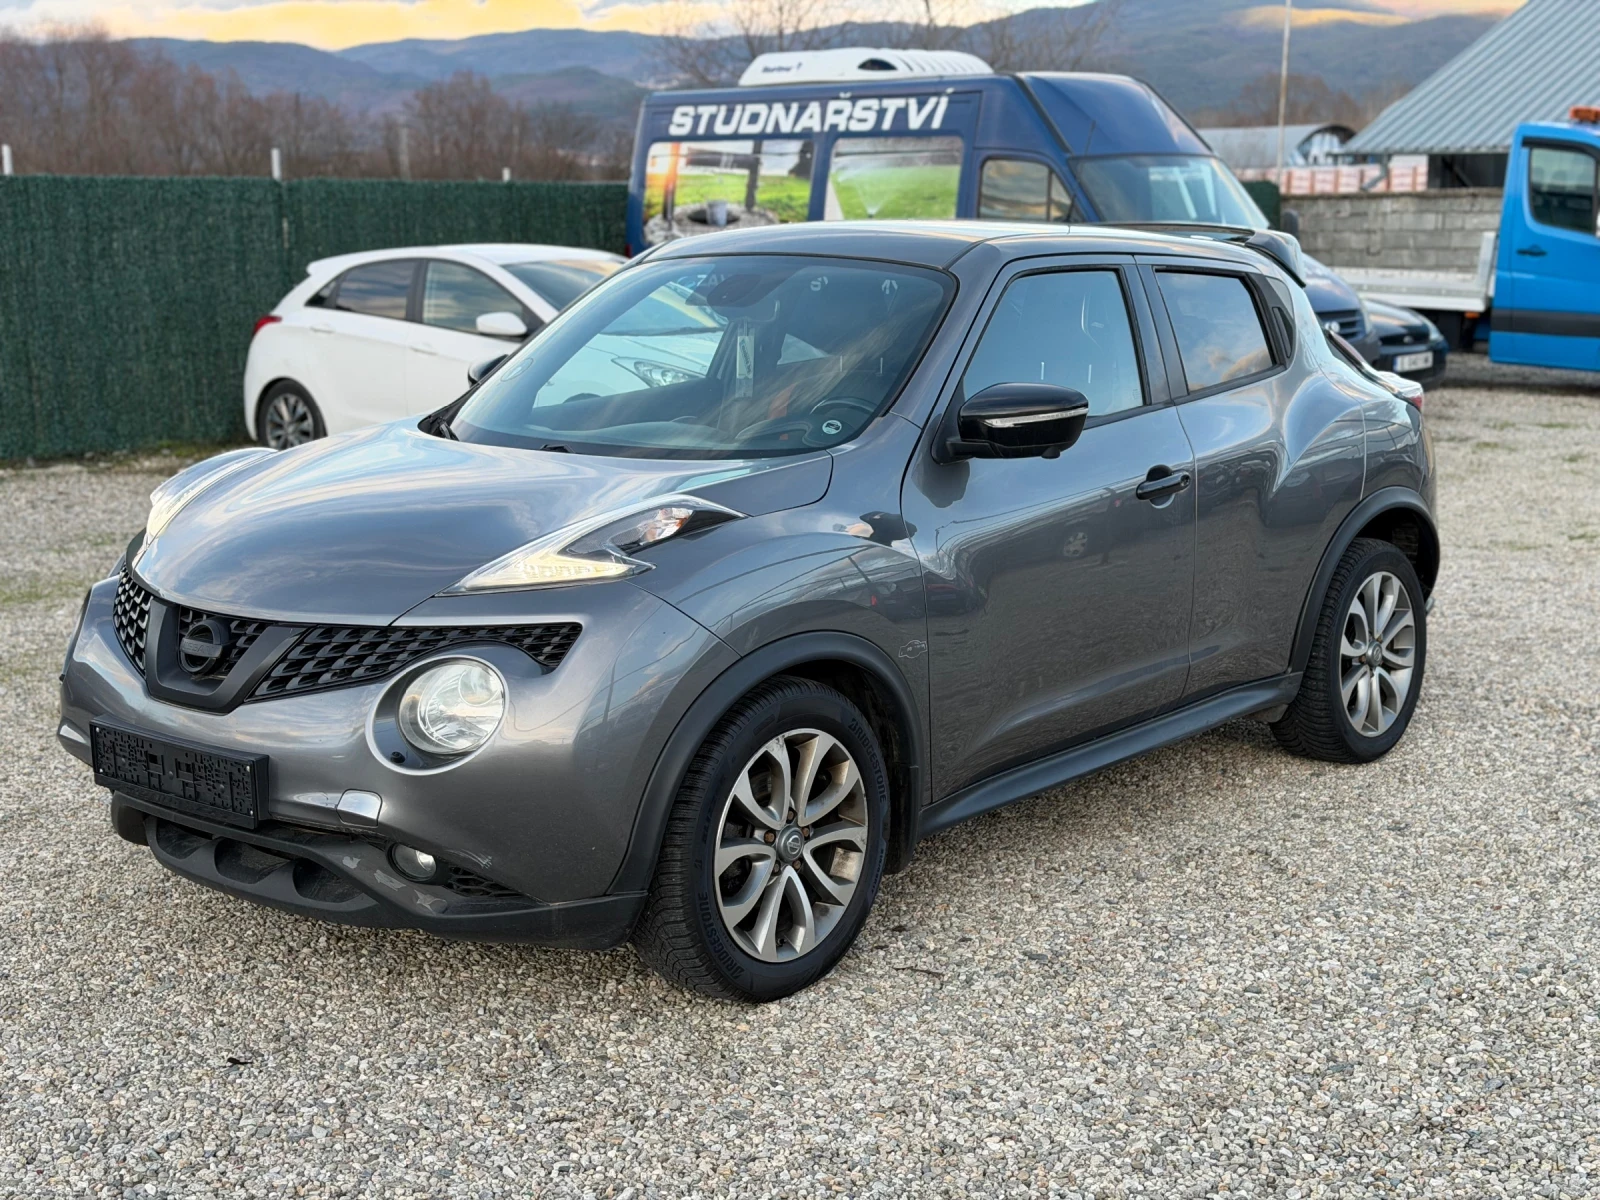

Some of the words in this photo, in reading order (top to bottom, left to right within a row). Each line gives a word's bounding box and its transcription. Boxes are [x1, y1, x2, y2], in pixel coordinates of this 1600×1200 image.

[668, 88, 954, 136] STUDNAŘSTVÍ
[848, 717, 887, 802] BRIDGESTONE
[698, 891, 745, 979] BRIDGESTONE
